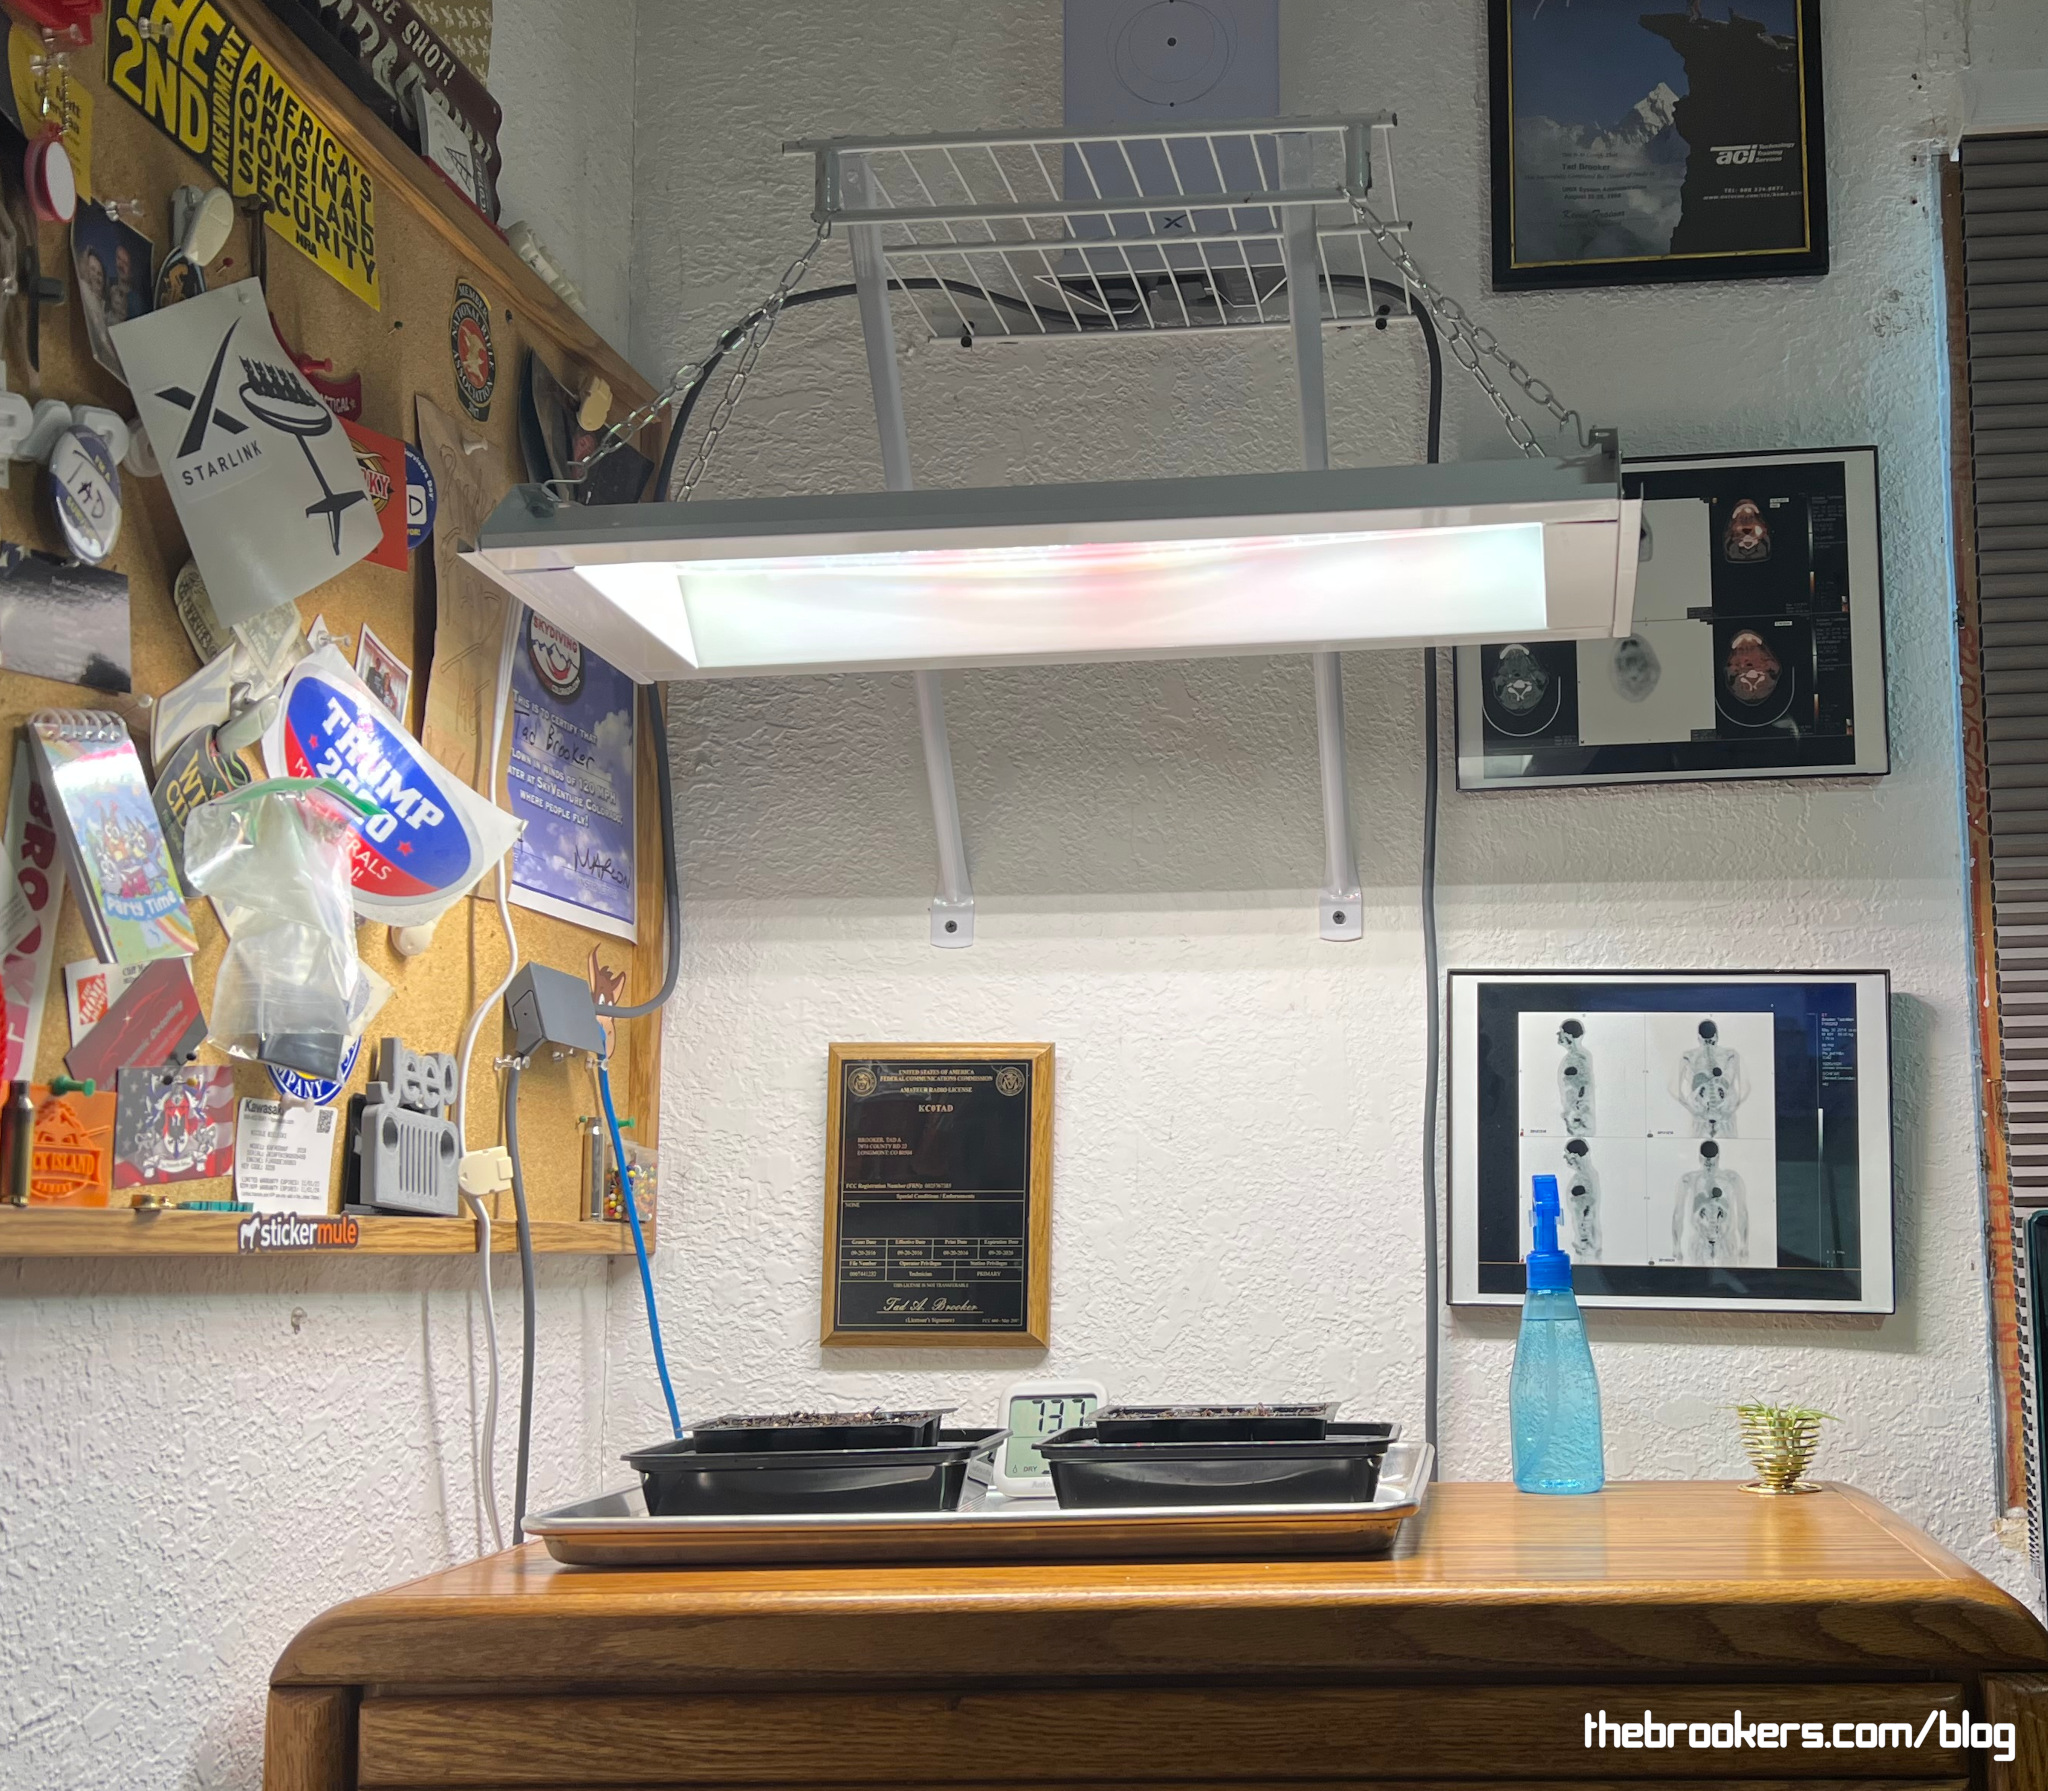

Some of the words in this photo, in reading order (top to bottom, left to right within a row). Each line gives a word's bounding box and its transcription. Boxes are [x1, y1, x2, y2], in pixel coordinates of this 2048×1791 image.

[401, 19, 456, 86] SHOT!
[112, 17, 209, 154] 2ND
[211, 25, 245, 184] AMENDMENT
[239, 88, 374, 233] ORIGINAL
[244, 61, 372, 202] AMERICA'S
[239, 119, 374, 255] HOMELAND
[238, 149, 376, 285] SECURITY
[295, 230, 319, 259] NRA
[458, 283, 488, 316] MEMBER
[452, 303, 481, 337] NATIONAL
[481, 322, 495, 368] RIFLE
[452, 349, 494, 402] ASSOCIATION
[181, 440, 262, 486] STARLINK
[533, 616, 578, 654] SKYDIVING
[513, 688, 530, 709] THIS
[532, 703, 539, 712] IS
[540, 707, 550, 719] TO
[551, 714, 579, 735] CERTIFY
[579, 728, 598, 743] THAT
[514, 709, 538, 746] Tad
[546, 724, 595, 769] Brooker
[321, 696, 445, 830] TRUMP
[511, 747, 532, 766] LOWN
[532, 760, 541, 770] IN
[542, 763, 564, 782] WINDS
[566, 776, 577, 786] OF
[579, 777, 596, 795] 120
[597, 785, 618, 805] MPH
[526, 775, 536, 785] AT
[520, 789, 544, 808] WHERE
[545, 801, 571, 820] PEOPLE
[572, 812, 589, 828] FLY!
[105, 895, 144, 918] Party
[146, 889, 178, 914] Time
[366, 1037, 458, 1118] Jeep
[53, 1152, 96, 1177] ISLAND
[260, 1216, 357, 1246] stickermule
[1988, 1184, 2015, 1300] DRIED
[883, 1297, 907, 1311] Tad
[909, 1297, 928, 1311] A.
[931, 1298, 978, 1311] Brooker
